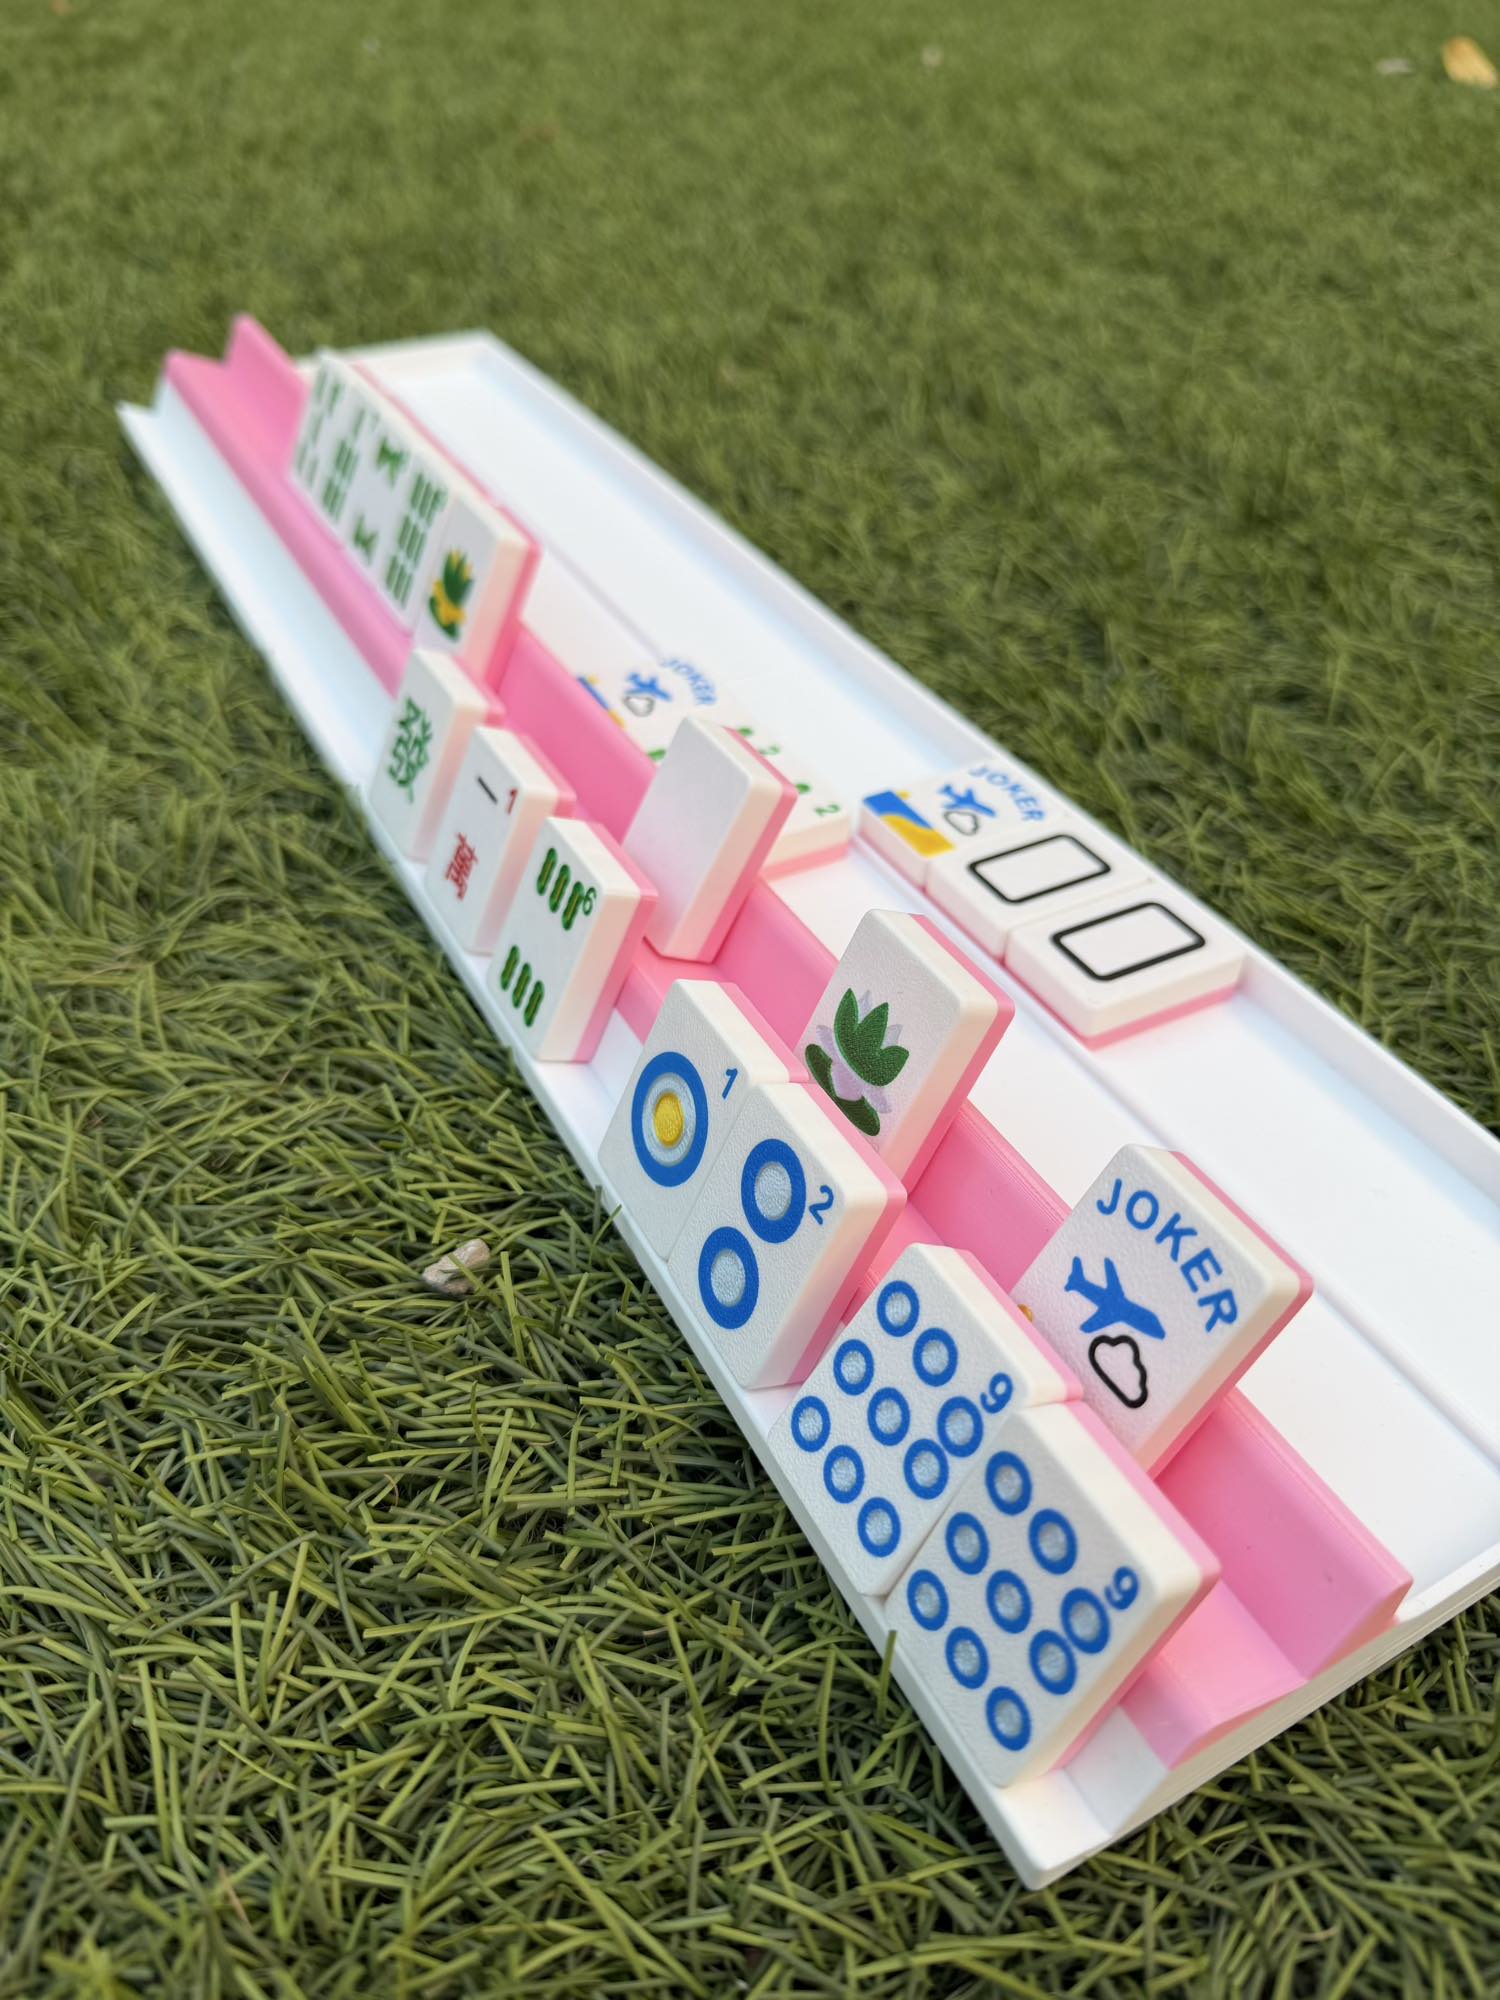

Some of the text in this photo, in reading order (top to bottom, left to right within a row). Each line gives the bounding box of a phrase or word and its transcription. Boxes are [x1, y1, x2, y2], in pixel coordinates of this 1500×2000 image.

[659, 657, 718, 707] JOKER
[507, 787, 518, 815] 1
[813, 804, 840, 817] 2
[969, 765, 1045, 822] JOKER
[583, 886, 598, 916] 6
[721, 1068, 739, 1100] 1
[808, 1184, 835, 1226] 2
[1096, 1178, 1238, 1333] JOKER
[979, 1372, 1014, 1414] 9
[1104, 1565, 1139, 1611] 9
